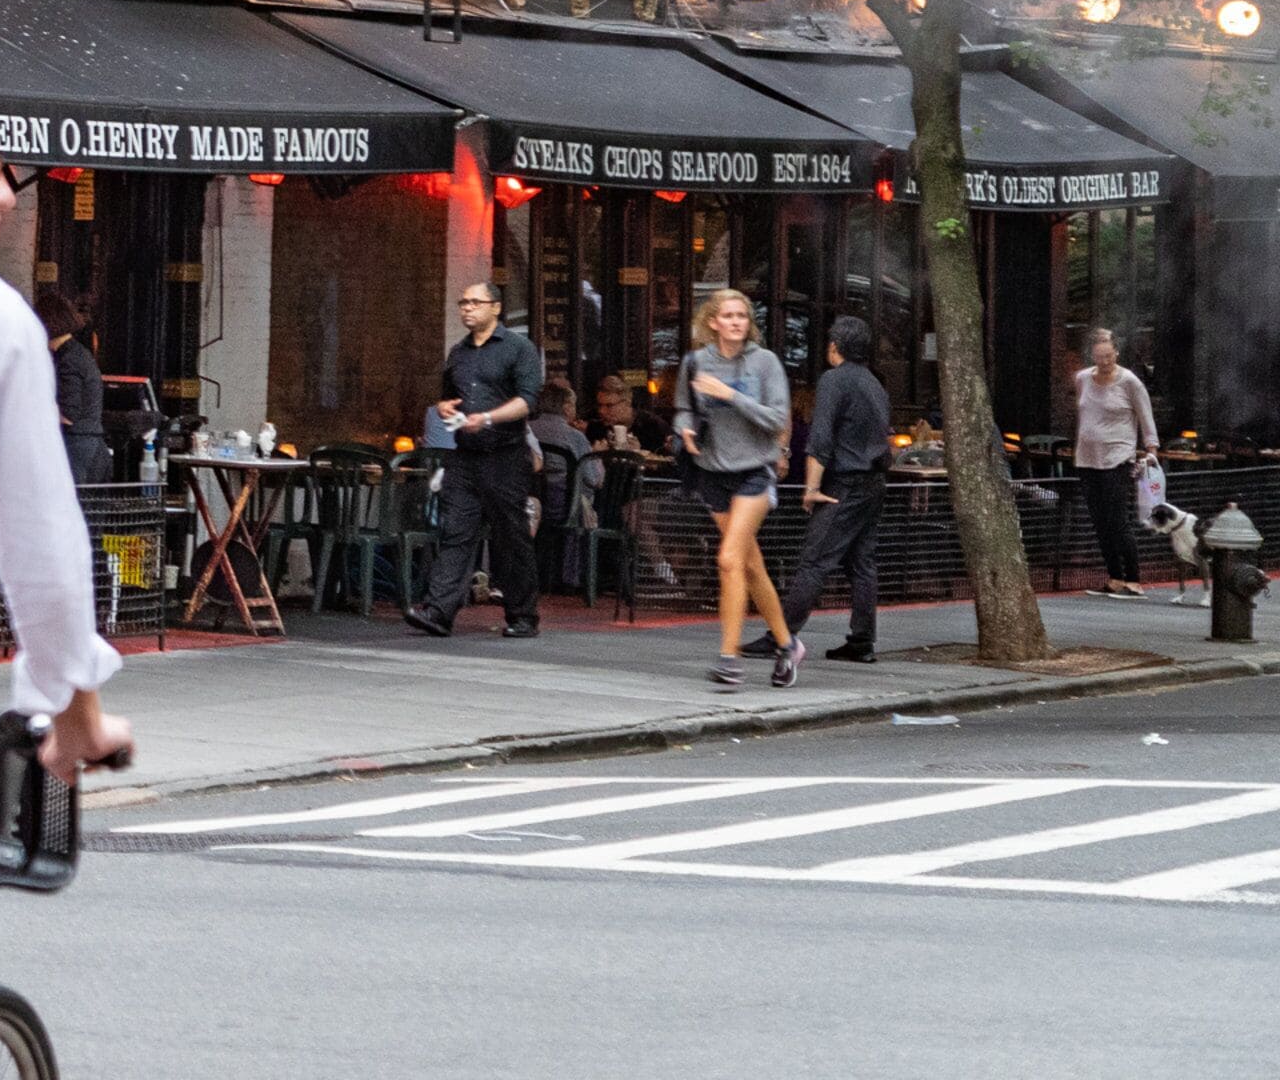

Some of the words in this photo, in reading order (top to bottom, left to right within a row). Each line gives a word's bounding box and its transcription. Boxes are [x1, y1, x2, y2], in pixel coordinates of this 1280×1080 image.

[59, 118, 180, 160] O.HENRY
[189, 125, 264, 162] MADE
[273, 127, 370, 163] FAMOUS
[514, 136, 594, 175] STEAKS
[603, 145, 663, 180] CHOPS
[671, 150, 758, 183] SEAFOOD
[1002, 176, 1056, 204] OLDEST
[1061, 172, 1127, 202] ORIGINAL
[1132, 170, 1160, 198] BAR
